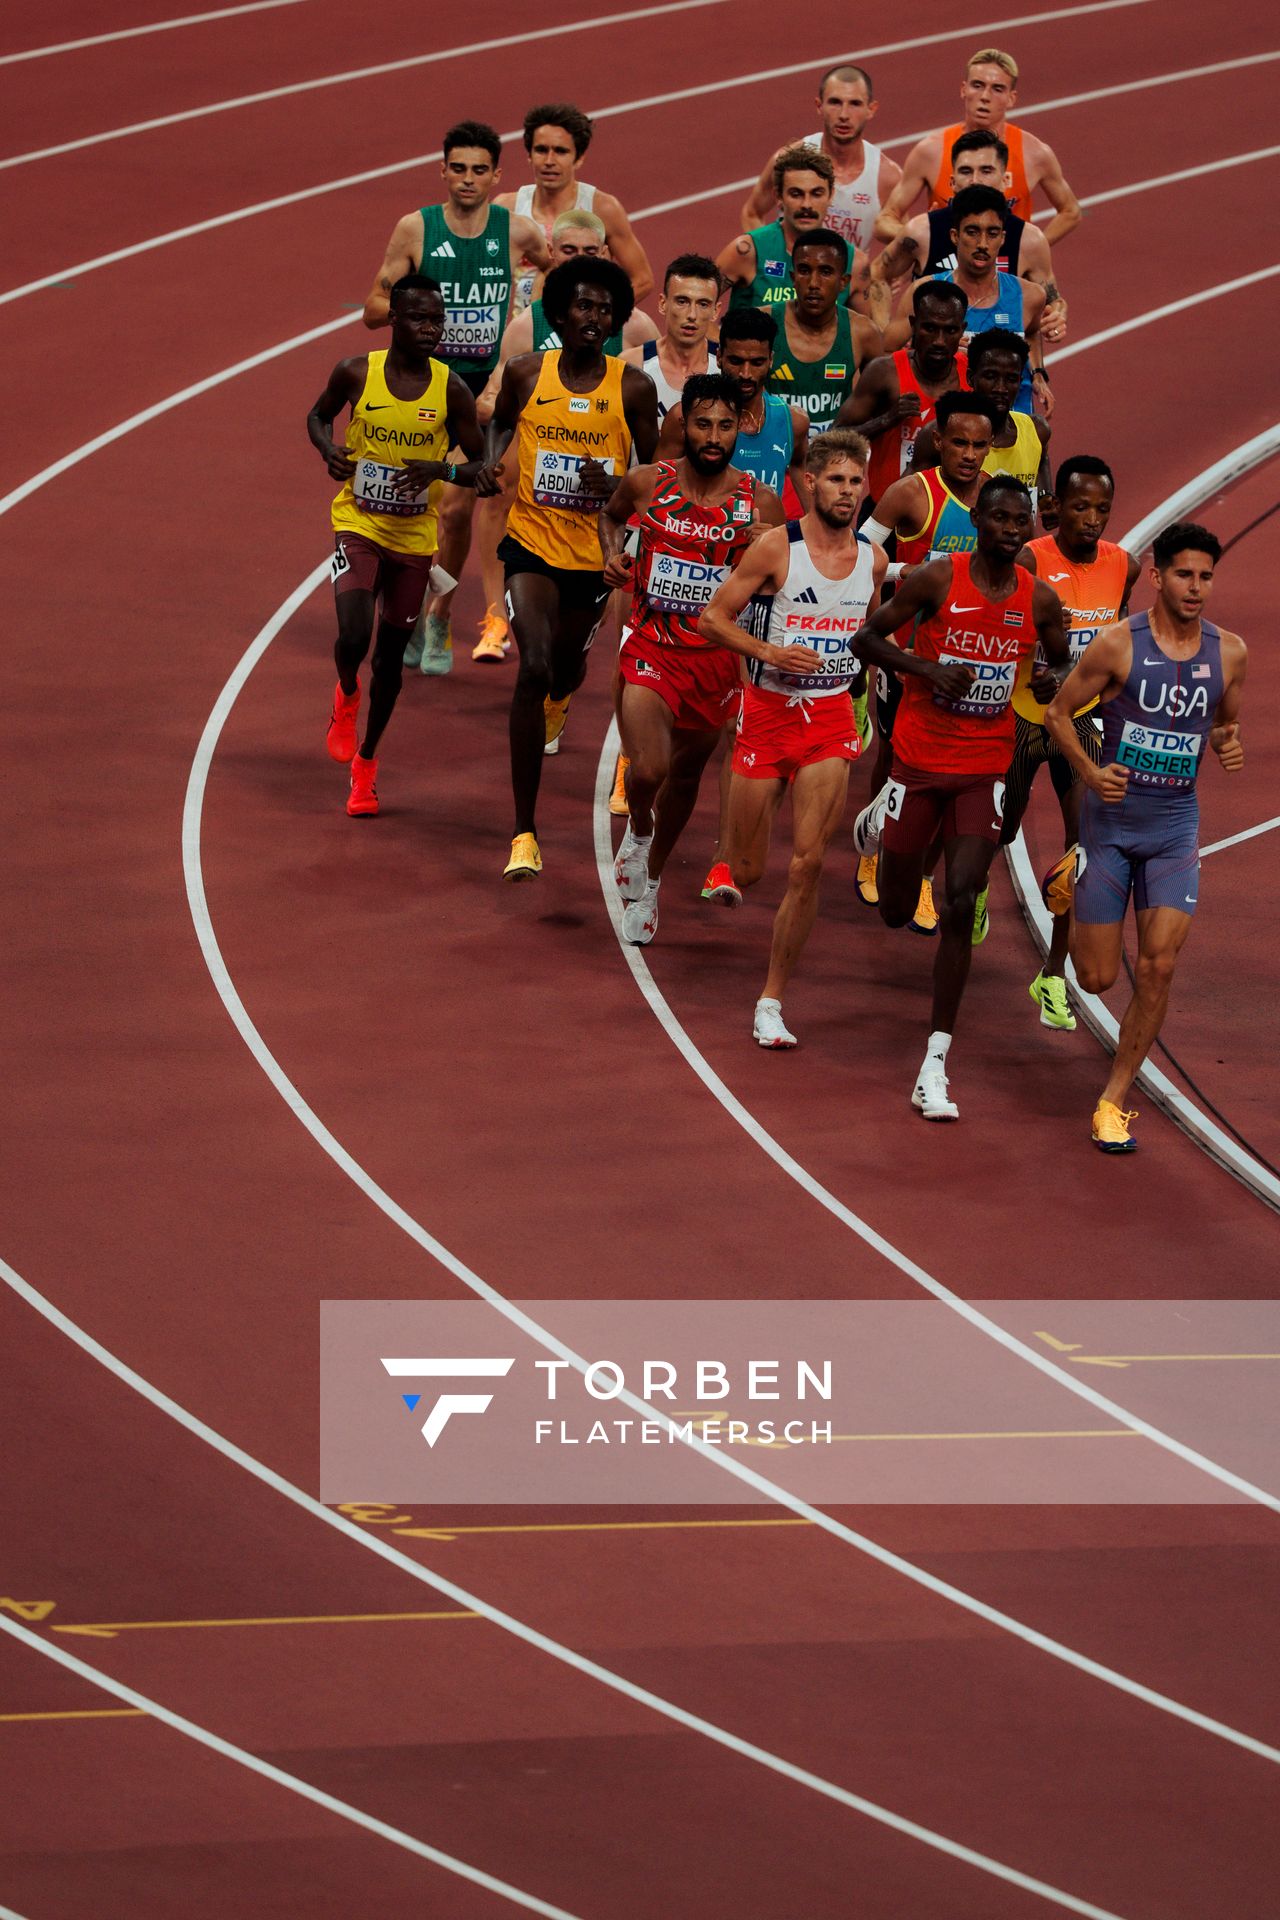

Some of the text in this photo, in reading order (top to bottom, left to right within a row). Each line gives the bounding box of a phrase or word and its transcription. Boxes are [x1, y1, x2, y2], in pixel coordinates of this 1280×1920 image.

[822, 215, 862, 232] REAT
[479, 267, 504, 276] 123.ie
[439, 282, 509, 304] ELAND
[447, 307, 495, 324] TDK
[440, 326, 497, 343] OSCORAN
[445, 345, 495, 354] TOKYO2
[772, 391, 843, 414] THIOPIA
[363, 424, 434, 447] UGANDA
[535, 425, 609, 446] GERMANY
[537, 473, 592, 495] ABDILA
[665, 517, 736, 542] MÉXICO
[673, 560, 724, 582] TDK
[651, 576, 719, 602] HERRER
[944, 626, 1019, 658] KENYA
[813, 657, 855, 674] SSIER
[1138, 679, 1208, 718] USA
[1147, 731, 1194, 753] TDK
[1122, 747, 1192, 775] FISHER
[888, 787, 897, 812] 6
